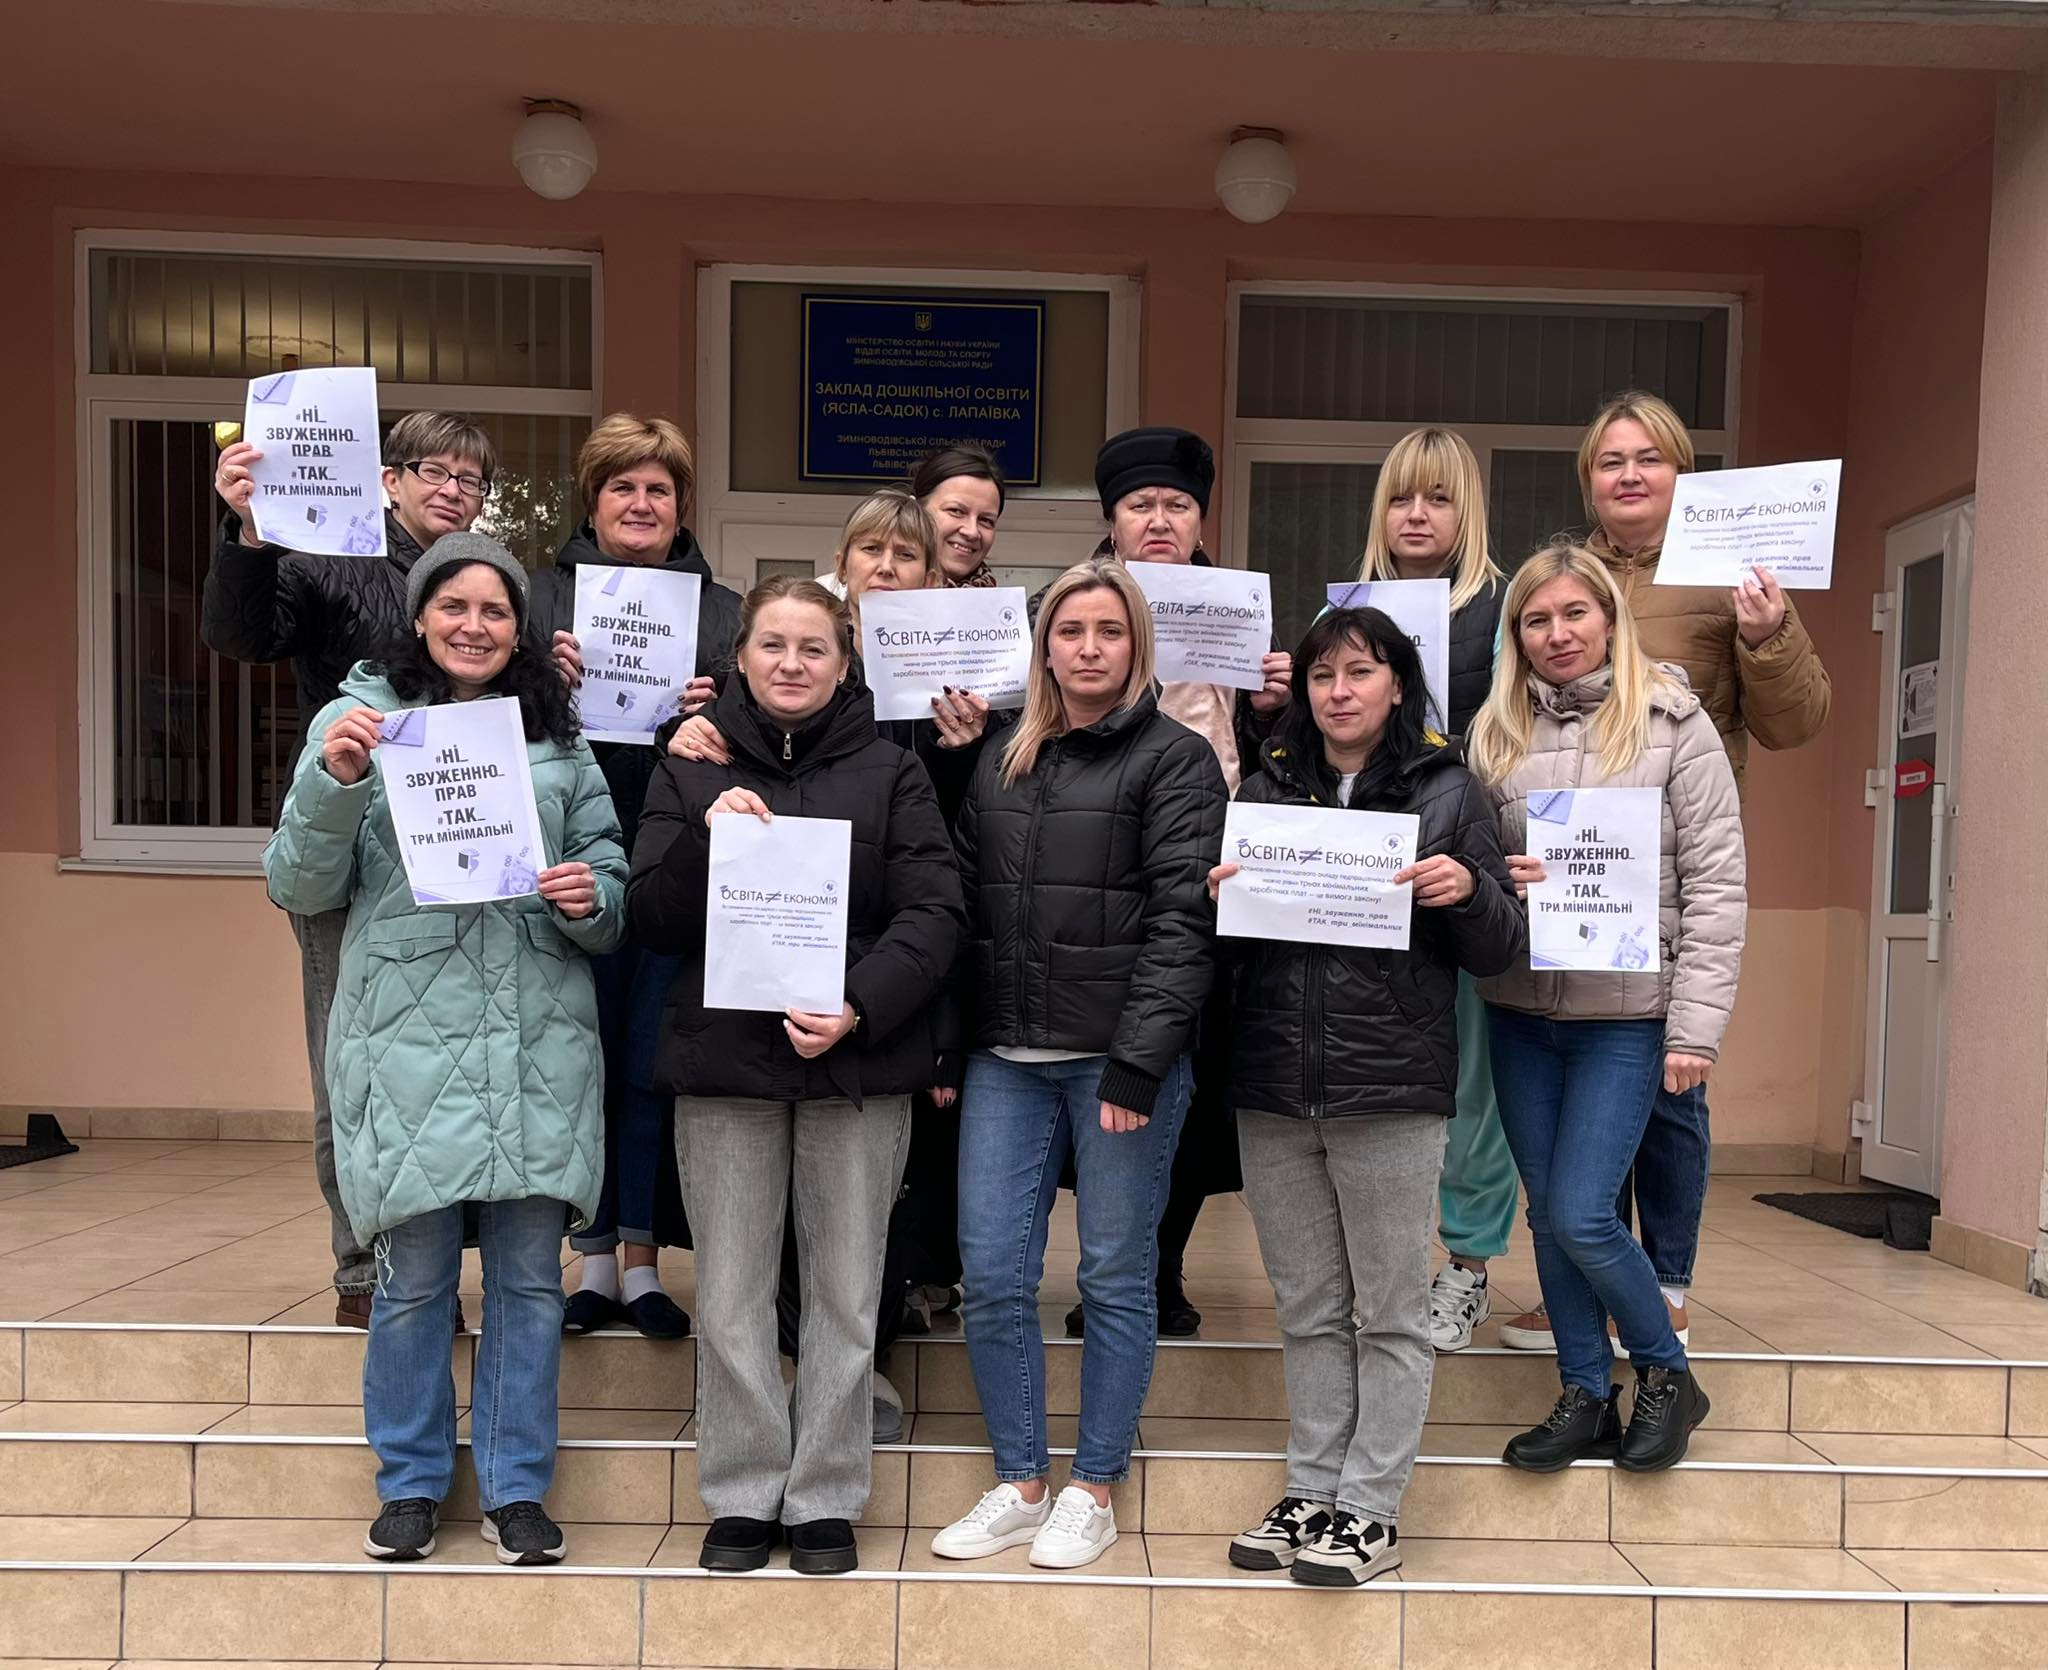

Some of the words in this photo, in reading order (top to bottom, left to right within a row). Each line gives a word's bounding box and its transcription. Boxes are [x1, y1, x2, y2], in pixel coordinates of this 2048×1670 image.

[972, 361, 993, 369] РАДИ
[815, 382, 872, 397] ЗАКЛАД
[875, 383, 970, 399] ДОШКІЛЬНОЇ
[974, 387, 1030, 401] ОСВІТИ
[822, 402, 929, 419] (ЯСЛА-САДОК)
[932, 407, 944, 418] с.
[948, 404, 1021, 420] ЛАПАЇВКА
[836, 434, 927, 446] ЗИМНОВОДІВСЬКОЇ
[1684, 506, 1735, 523] ОСВІТА
[1758, 500, 1827, 516] ЕКОНОМІЯ
[1149, 601, 1184, 615] СВІТА
[1207, 605, 1265, 620] ЕКОНОМІЯ
[612, 633, 648, 648] ПРАВ
[877, 628, 932, 646] ОСВІТА
[958, 628, 1021, 643] ЕКОНОМІЯ
[435, 784, 477, 802] ПРАВ
[1239, 843, 1297, 862] ОСВІТА
[1325, 851, 1403, 870] ЕКОНОМІЯ
[1567, 863, 1606, 876] ПРАВ
[1290, 889, 1307, 898] плат
[1325, 893, 1352, 901] вимога
[1299, 880, 1321, 889] трьох
[1322, 882, 1369, 892] мінімальних
[721, 886, 764, 902] ОСВІТА
[783, 893, 838, 905] ЕКОНОМІЯ
